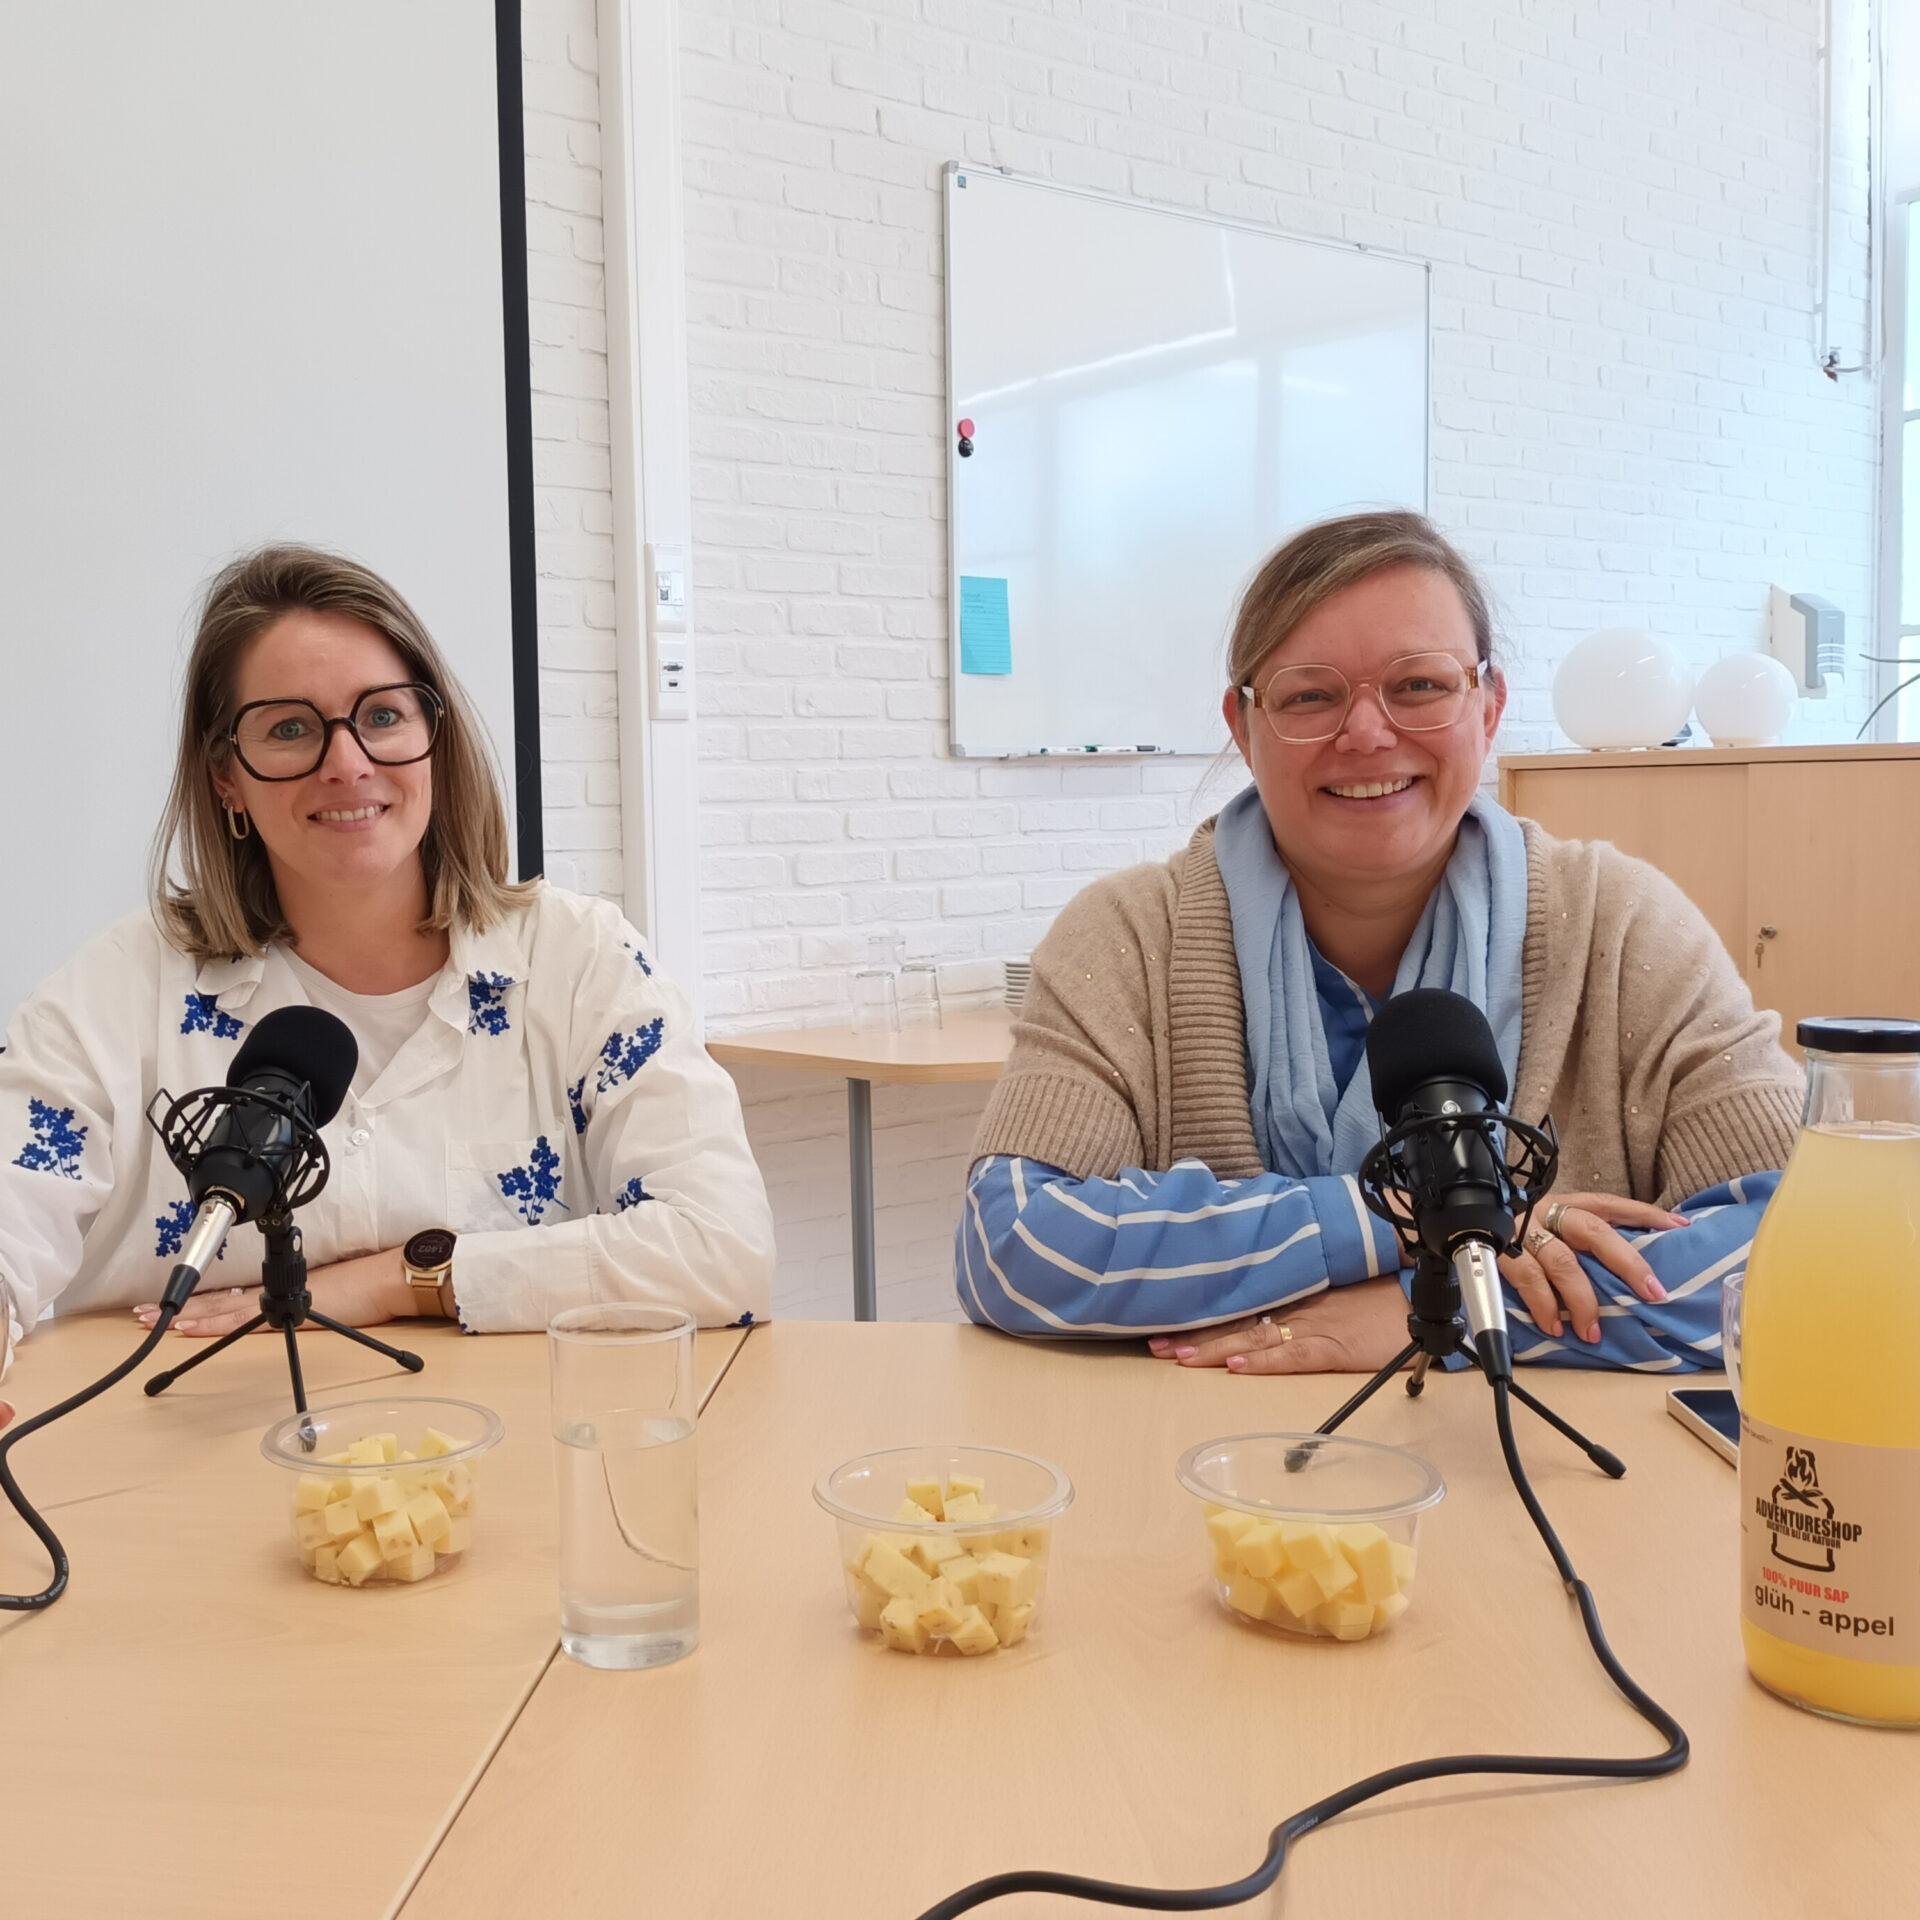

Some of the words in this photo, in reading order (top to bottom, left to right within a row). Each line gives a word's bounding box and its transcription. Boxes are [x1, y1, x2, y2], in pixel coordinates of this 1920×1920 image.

[1755, 1496, 1862, 1542] ADVENTURESHOP
[1766, 1519, 1790, 1536] DICHTER
[1802, 1531, 1810, 1542] DE
[1812, 1534, 1841, 1549] NATUUR
[1762, 1566, 1787, 1587] 100%
[1789, 1577, 1821, 1598] PUUR
[1824, 1587, 1850, 1603] SAP
[1755, 1585, 1794, 1615] glüh
[1818, 1609, 1894, 1637] appel
